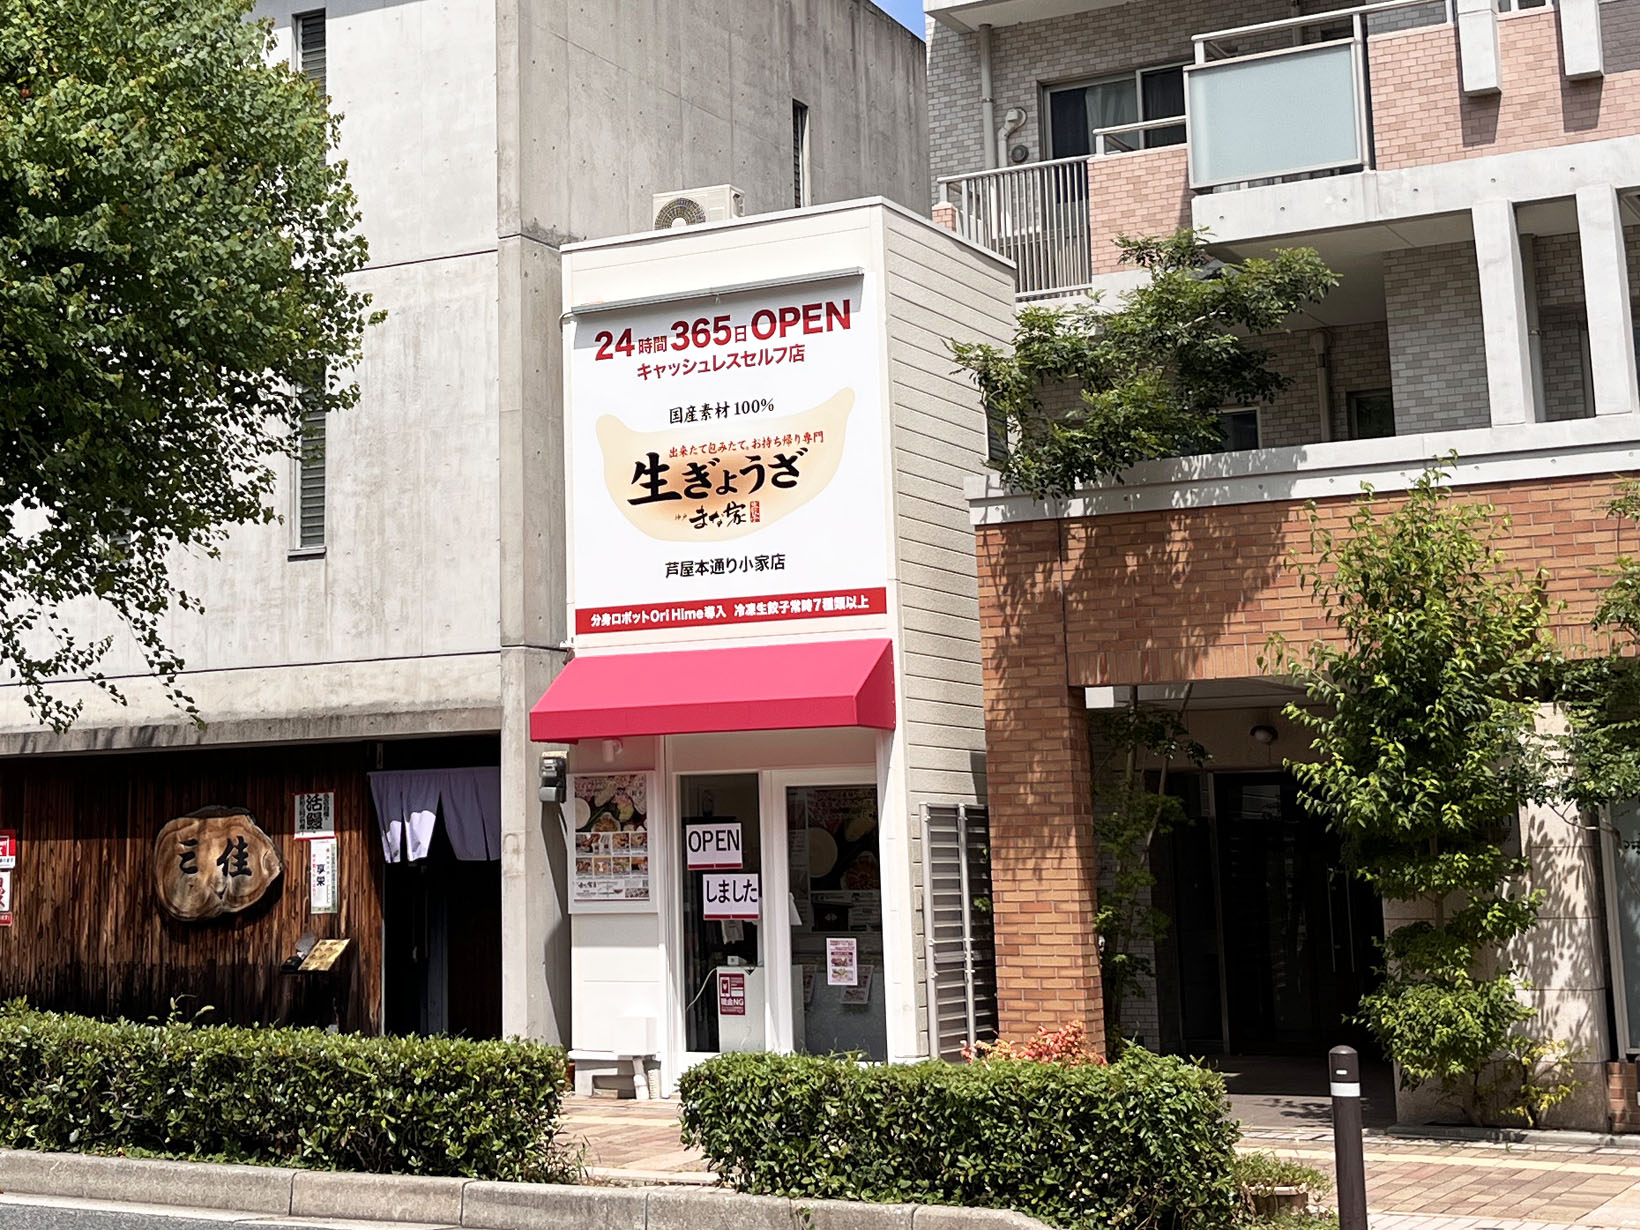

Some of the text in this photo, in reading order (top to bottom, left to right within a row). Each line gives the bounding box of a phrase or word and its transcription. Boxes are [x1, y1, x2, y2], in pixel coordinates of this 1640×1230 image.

[637, 344, 805, 381] キャッシュレスセルフ店
[627, 447, 808, 505] 生ぎょうざ
[665, 553, 786, 578] 芦屋本通り小家店
[688, 829, 740, 853] OPEN
[706, 879, 758, 903] しました
